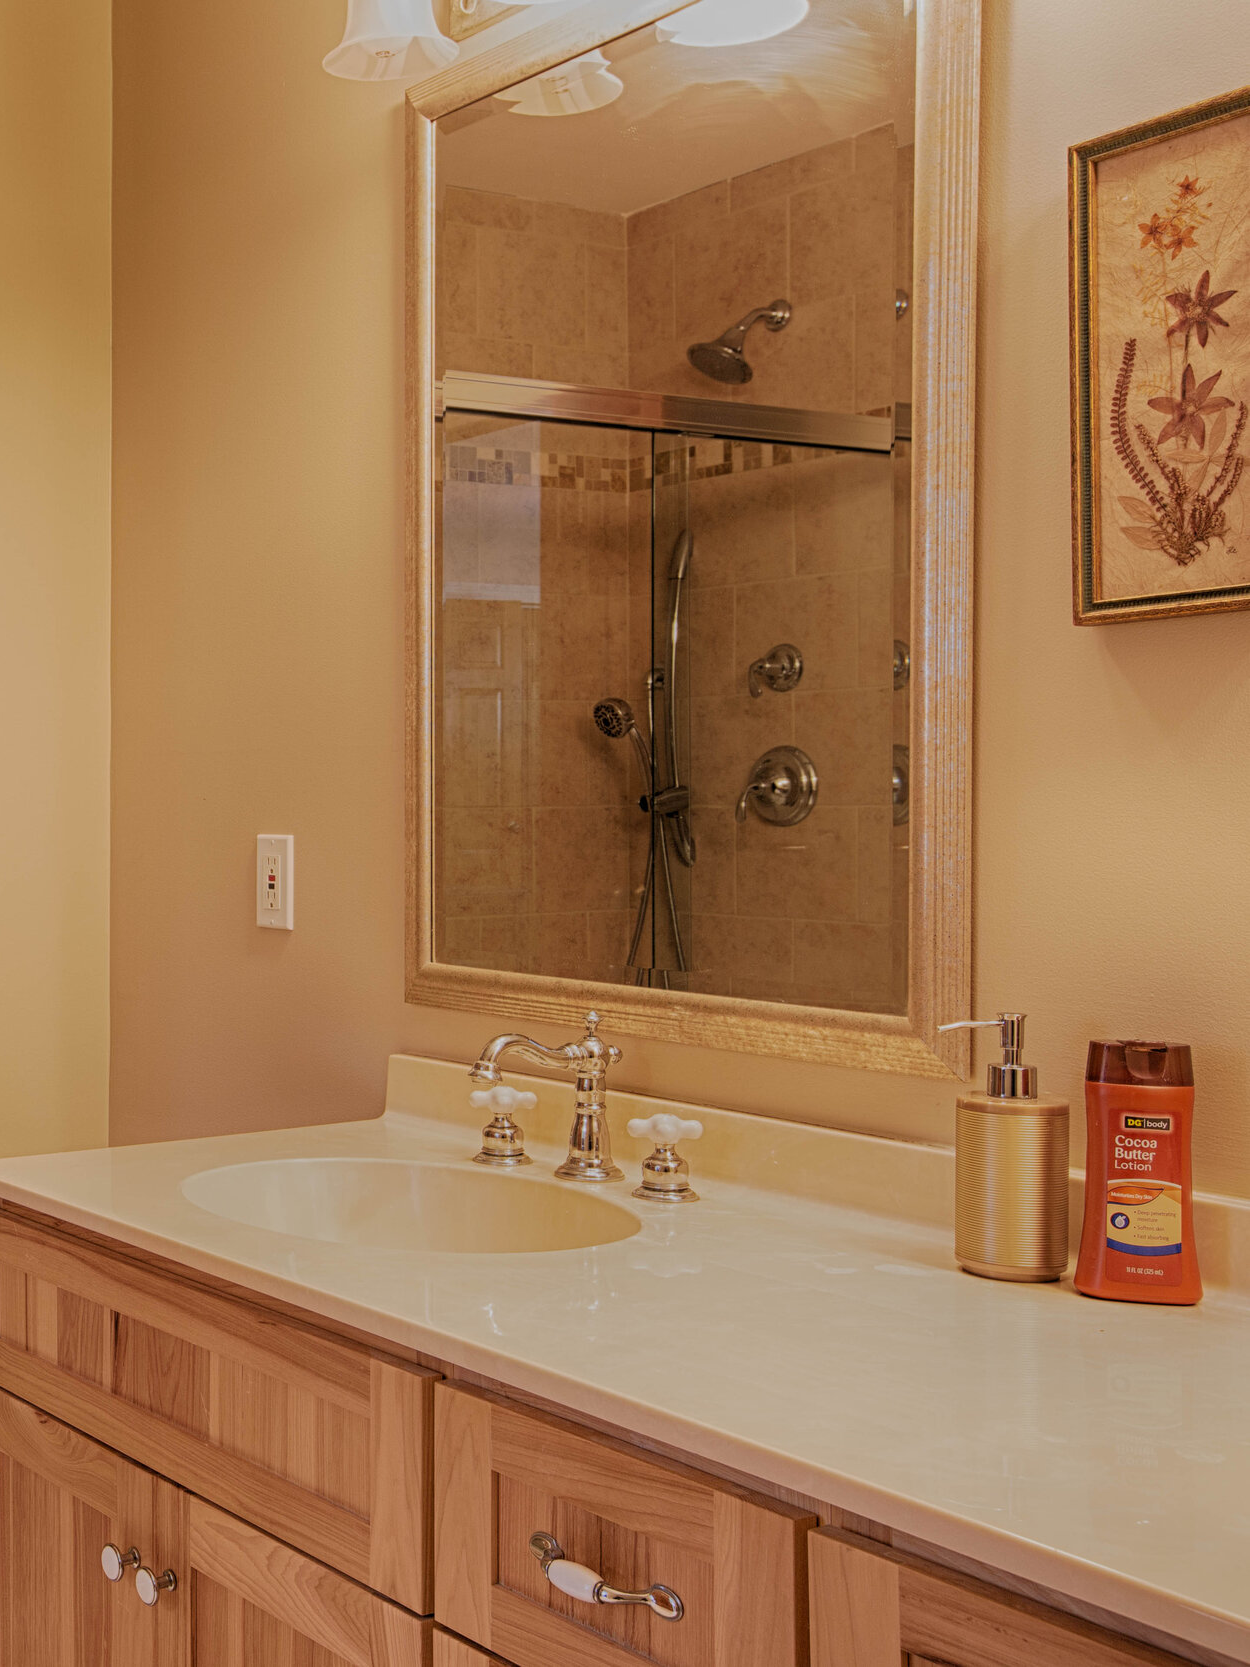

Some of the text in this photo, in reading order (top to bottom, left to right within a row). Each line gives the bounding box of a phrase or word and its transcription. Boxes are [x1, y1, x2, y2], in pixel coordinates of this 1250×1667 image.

[1146, 1119, 1168, 1129] body
[1115, 1135, 1157, 1148] Cocoa
[1115, 1147, 1156, 1161] Butter
[1114, 1160, 1152, 1171] Lotion
